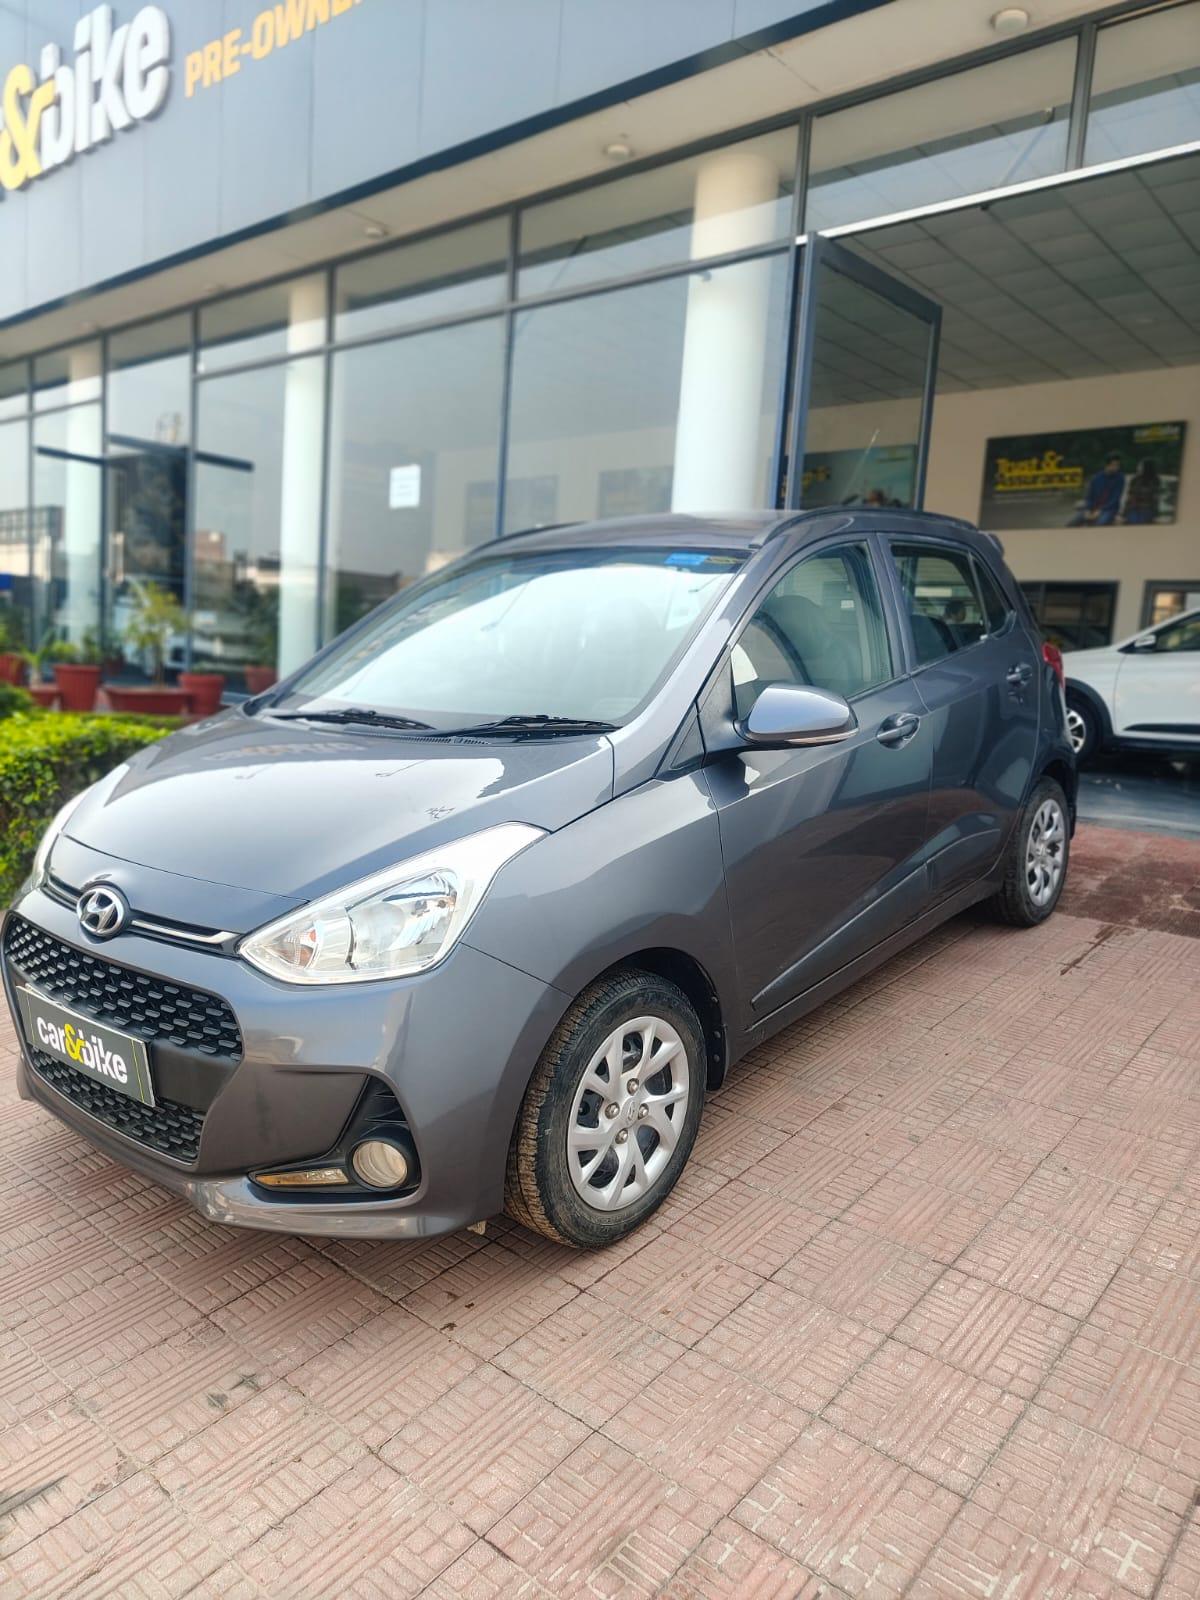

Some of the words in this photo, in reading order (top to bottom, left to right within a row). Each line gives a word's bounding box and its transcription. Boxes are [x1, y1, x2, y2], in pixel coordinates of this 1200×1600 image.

[0, 3, 170, 190] &bike
[184, 0, 363, 99] PRE-OWN
[36, 1016, 128, 1084] car&bike
